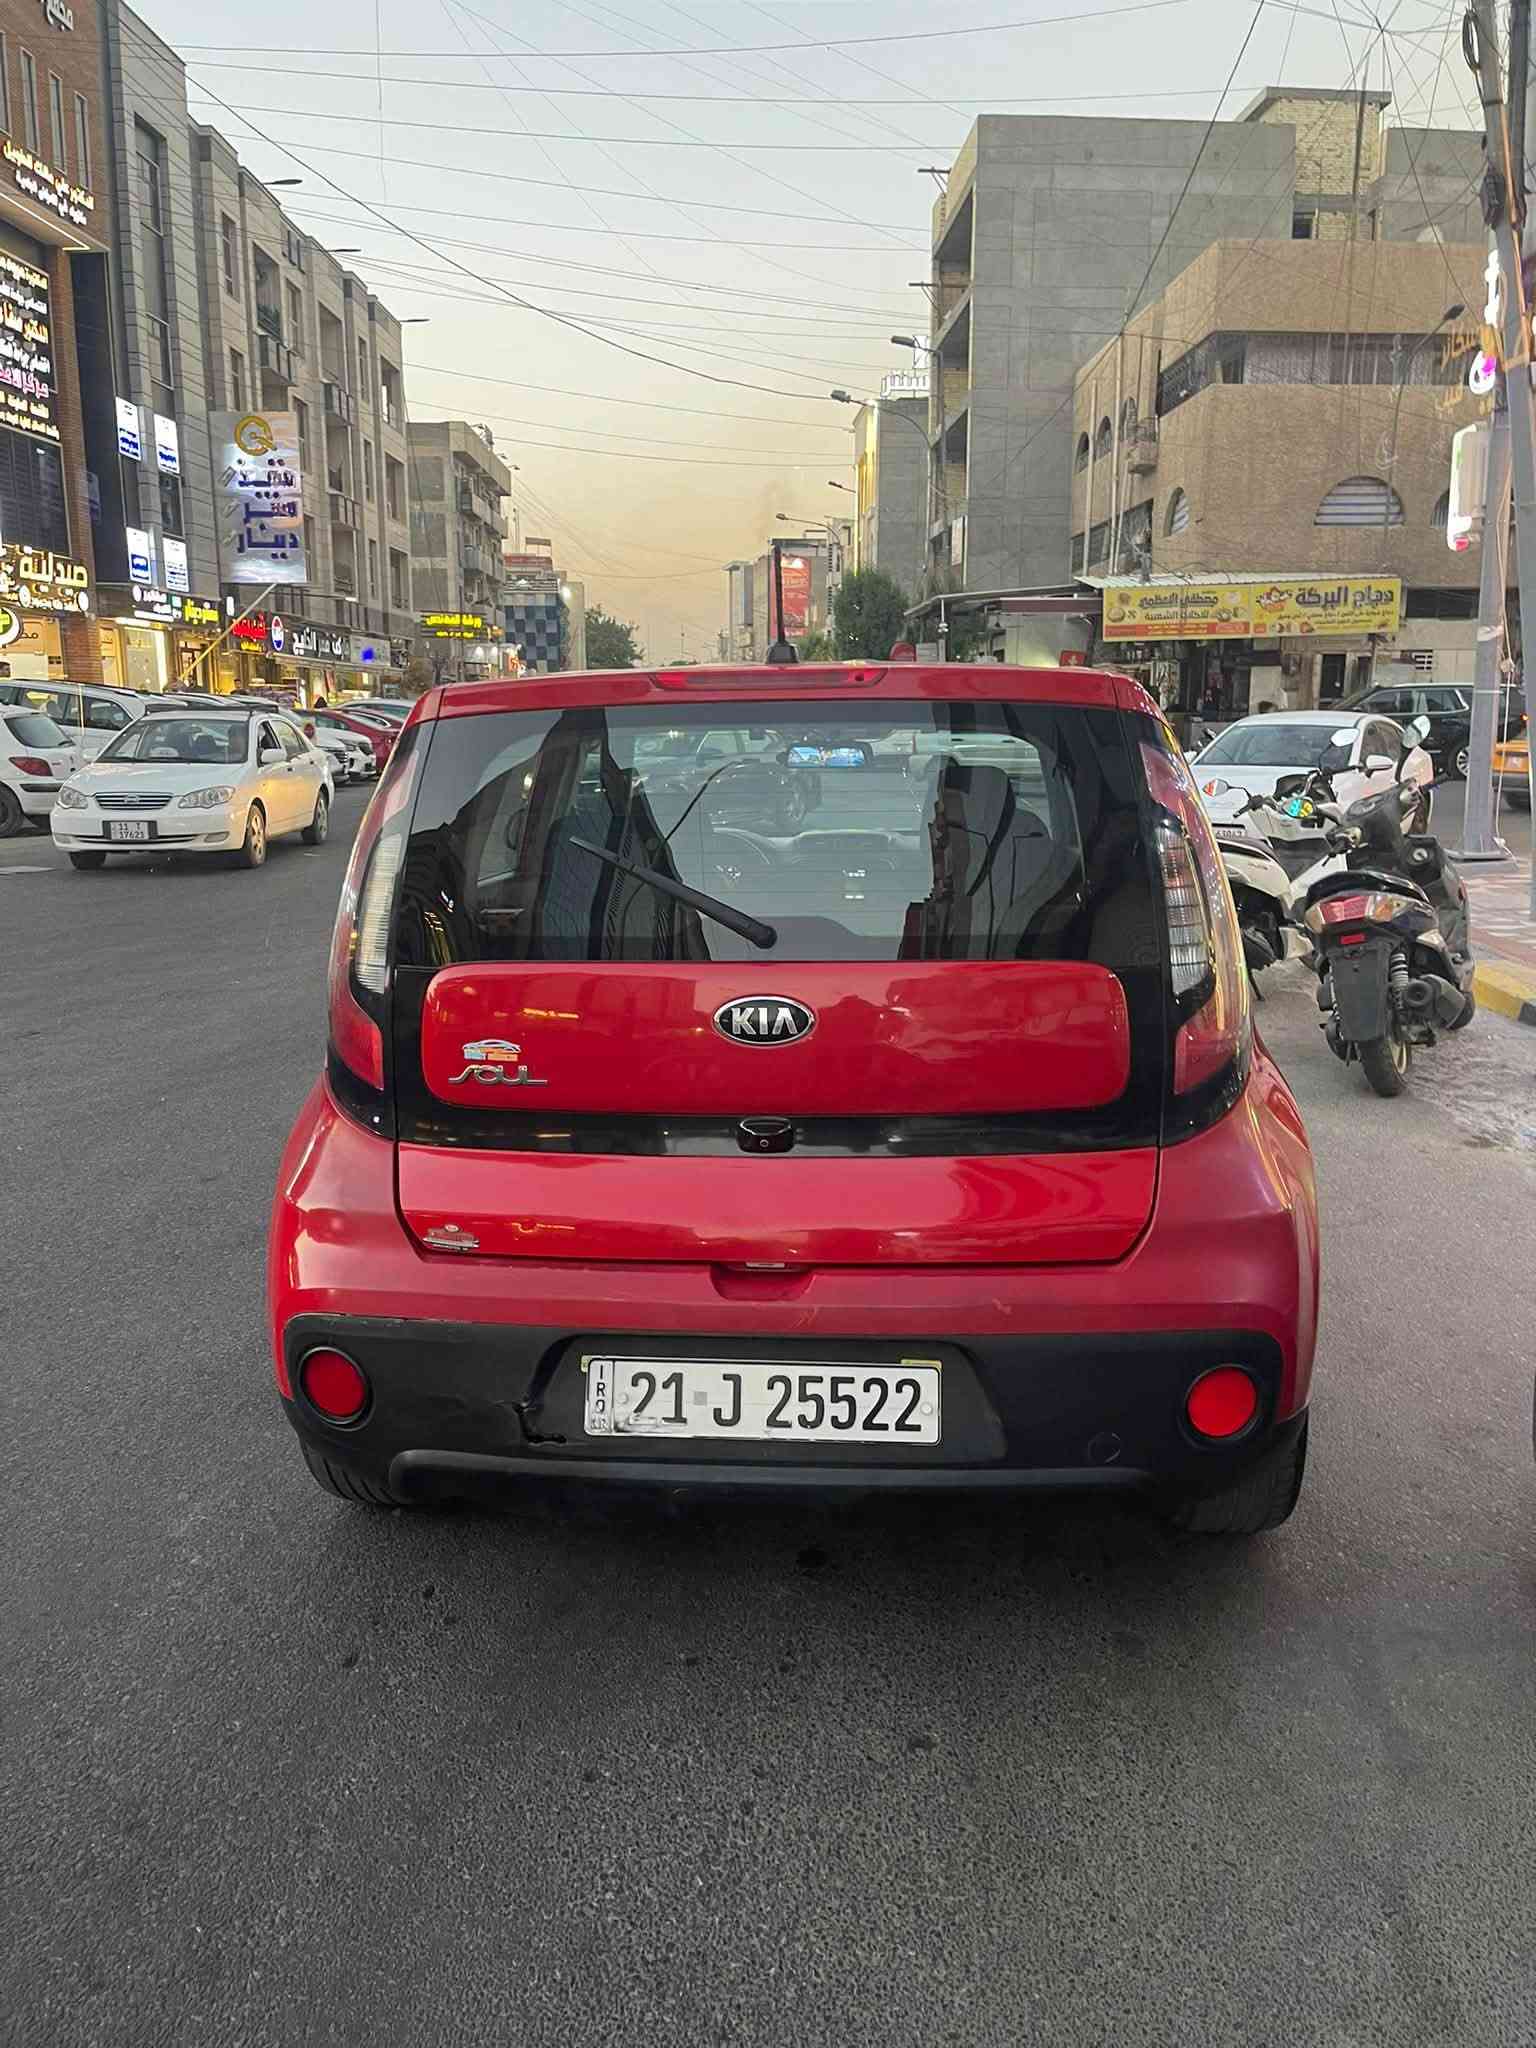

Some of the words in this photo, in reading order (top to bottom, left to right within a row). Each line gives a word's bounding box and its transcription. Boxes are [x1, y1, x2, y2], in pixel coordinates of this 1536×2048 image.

[1296, 586, 1348, 609] البركة
[731, 1007, 799, 1035] KIA
[630, 1371, 688, 1425] 21
[712, 1373, 742, 1427] J
[766, 1374, 922, 1432] 25522
